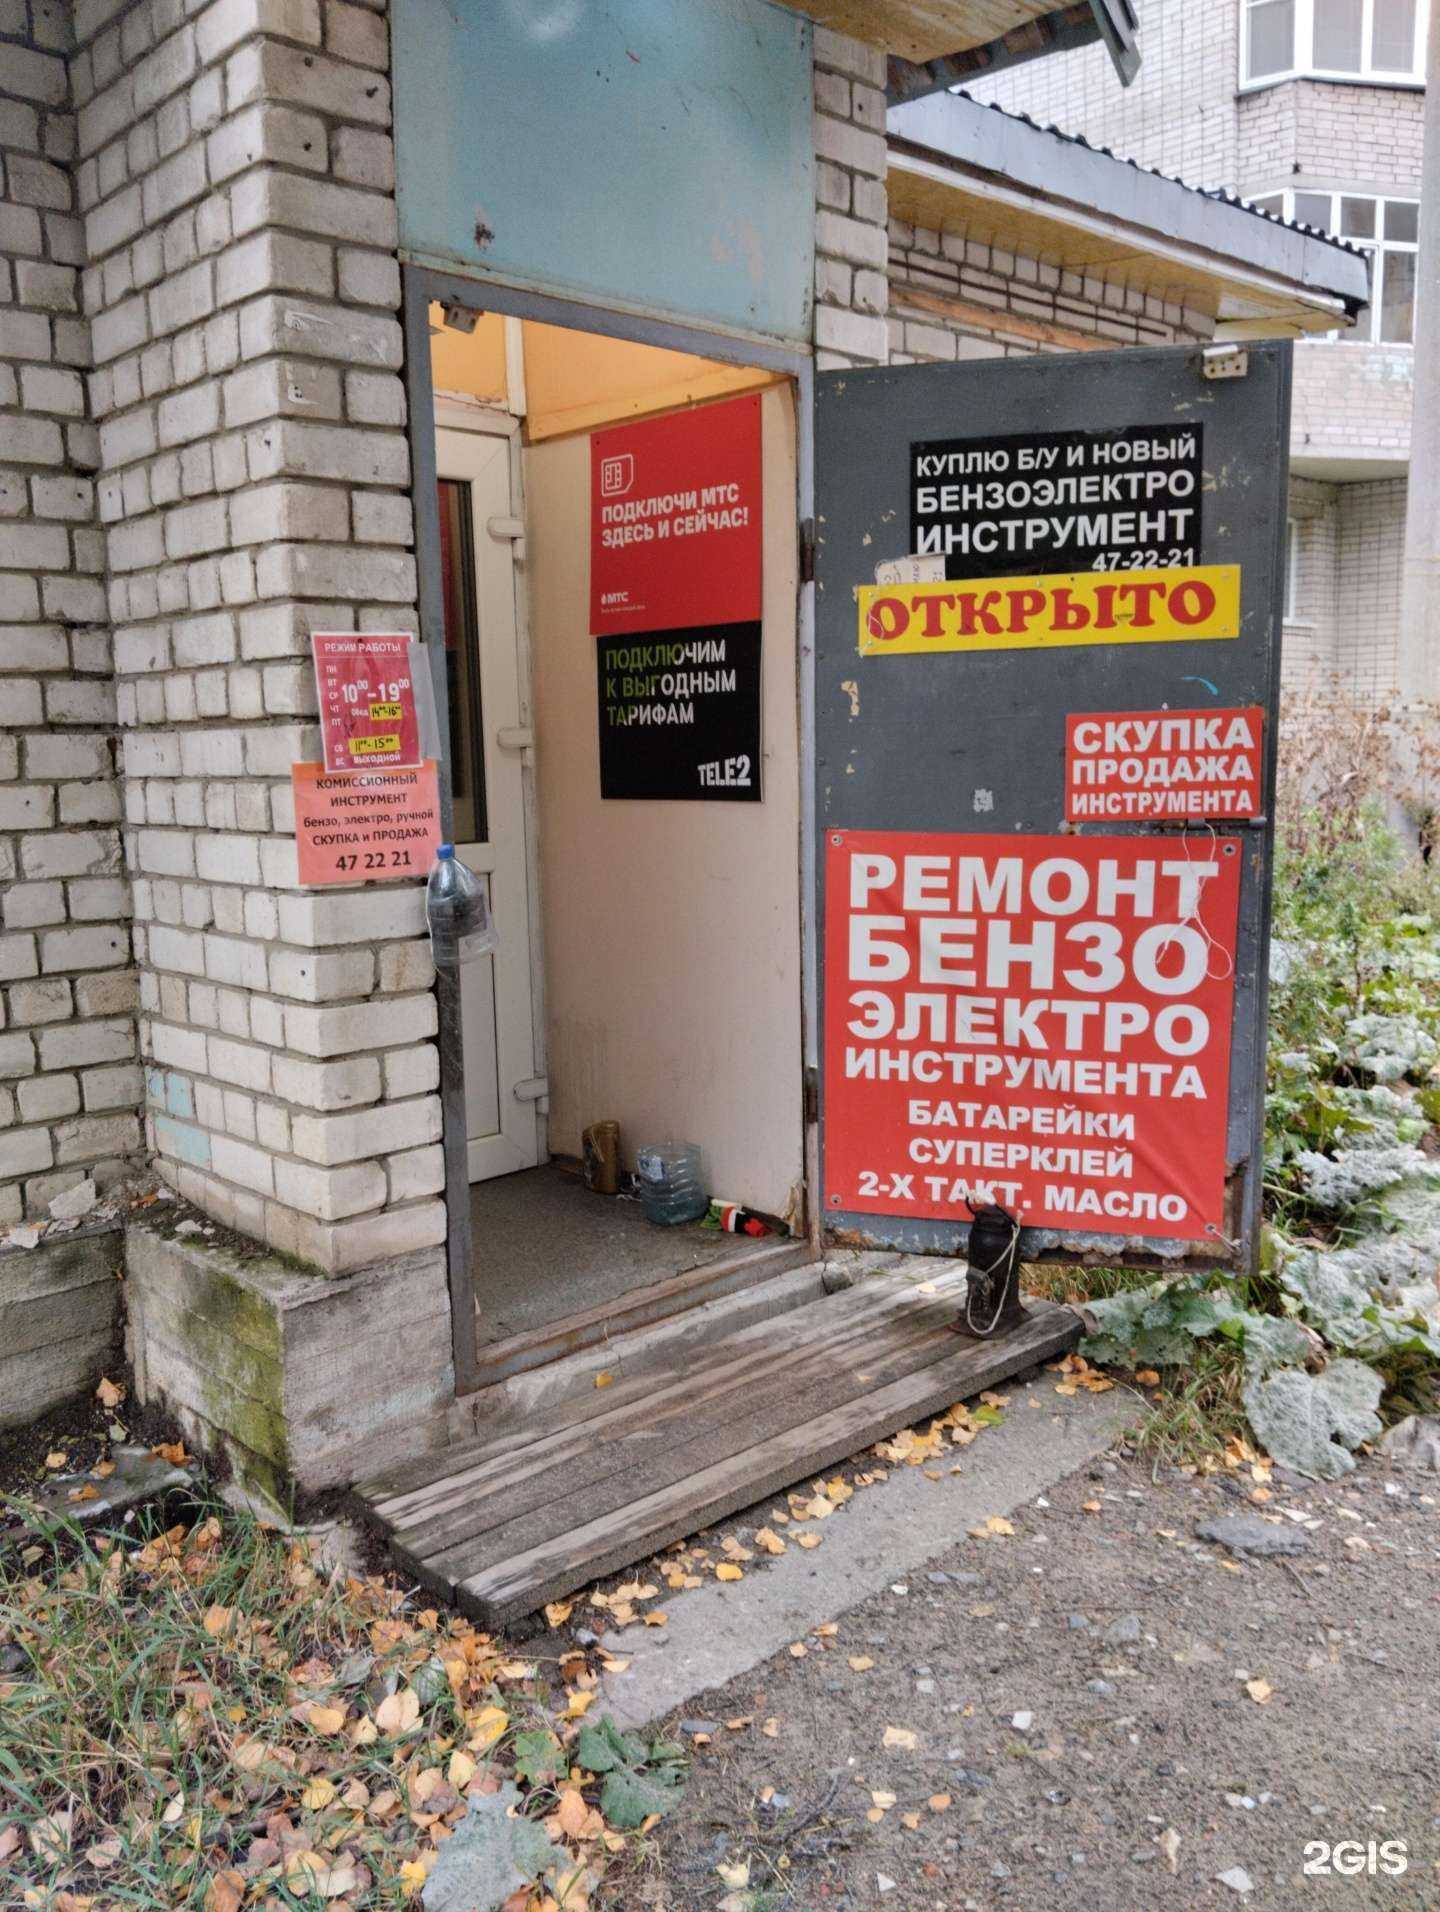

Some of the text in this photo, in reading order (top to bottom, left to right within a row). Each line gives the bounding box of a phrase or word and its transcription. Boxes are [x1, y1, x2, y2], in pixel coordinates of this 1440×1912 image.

[917, 433, 1196, 477] КУПЛЮ Б/У И НОВЫЙ
[602, 483, 740, 524] ПОДКЛЮЧИ МТС
[917, 470, 1195, 514] БЕНЗОЭЛЕКТРО
[602, 507, 749, 549] ЗДЕСЬ И СЕЙЧАС!
[917, 509, 1195, 555] ИНСТРУМЕНТ
[1092, 547, 1194, 572] 47-22-21
[607, 591, 629, 604] МТС
[866, 580, 1217, 641] ОТКРЫТО
[324, 642, 401, 653] РЕЖИМ РАБОТЫ
[606, 639, 727, 672] ПОДКЛЮЧИМ
[326, 665, 337, 673] ПН
[327, 679, 337, 687] ВТ
[606, 669, 736, 700] К ВЫГОДНЫМ
[328, 691, 338, 700] СР
[330, 705, 340, 713] ЧТ
[331, 718, 342, 727] ПТ
[606, 702, 695, 727] ТАРИФАМ
[1073, 717, 1255, 754] СКУПКА
[353, 752, 401, 764] ВЫХОДНОЙ
[697, 754, 751, 787] TELE2
[1072, 755, 1254, 788] ПРОДАЖА
[316, 772, 418, 790] КОМИССИОННЫЙ
[330, 792, 408, 808] ИНСТРУМЕНТ
[1072, 790, 1254, 815] ИНСТРУМЕНТА
[303, 808, 434, 828] бензо, электро, ручной
[312, 832, 360, 847] СКУПКА
[372, 827, 429, 842] ПРОДАЖА
[336, 850, 412, 872] 47 22 21
[850, 852, 1220, 919] РЕМОНТ
[848, 914, 1209, 996] БЕНЗО
[846, 990, 1210, 1057] ЭЛЕКТРО
[845, 1046, 1207, 1099] ИНСТРУМЕНТА
[908, 1100, 1136, 1141] БАТАРЕЙКИ
[908, 1137, 1134, 1178] СУПЕРКЛЕЙ
[858, 1171, 1189, 1222] 2-Х ТАКТ. МАСЛО
